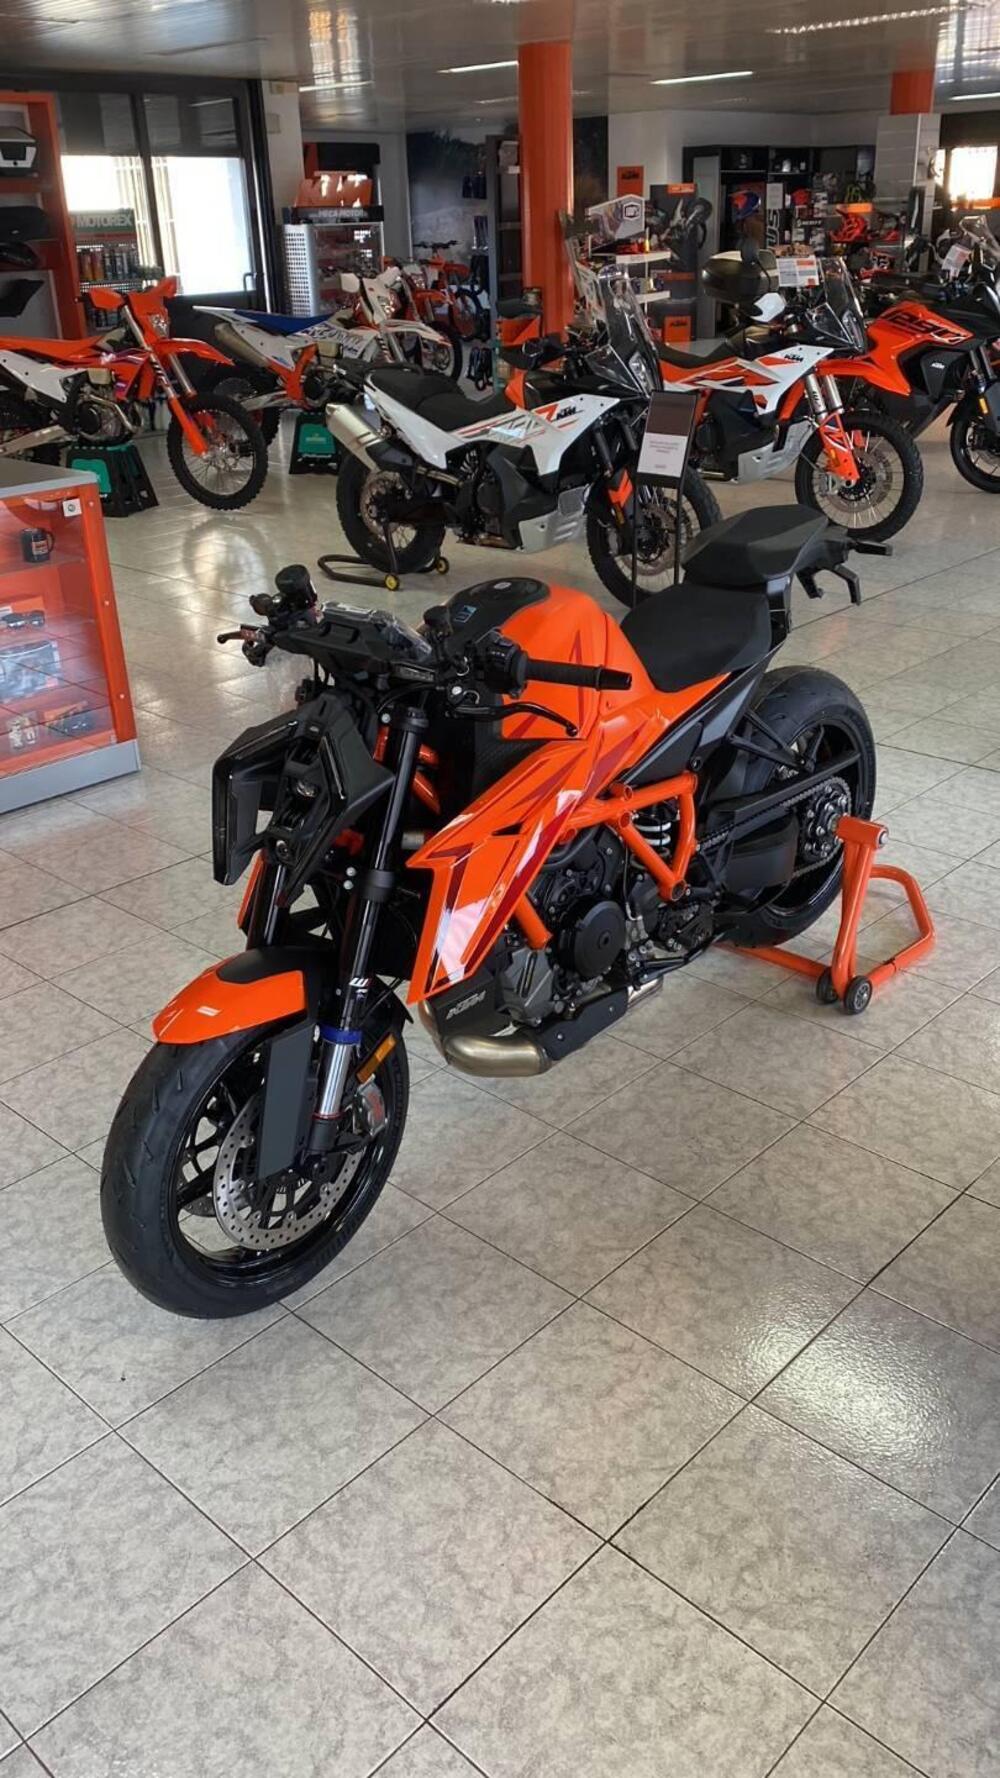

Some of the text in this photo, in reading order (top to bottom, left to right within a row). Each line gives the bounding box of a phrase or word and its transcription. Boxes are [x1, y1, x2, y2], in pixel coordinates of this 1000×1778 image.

[76, 213, 133, 227] MOTOREX
[784, 353, 803, 362] KTM
[556, 406, 577, 420] KTM
[446, 990, 486, 1020] KTM
